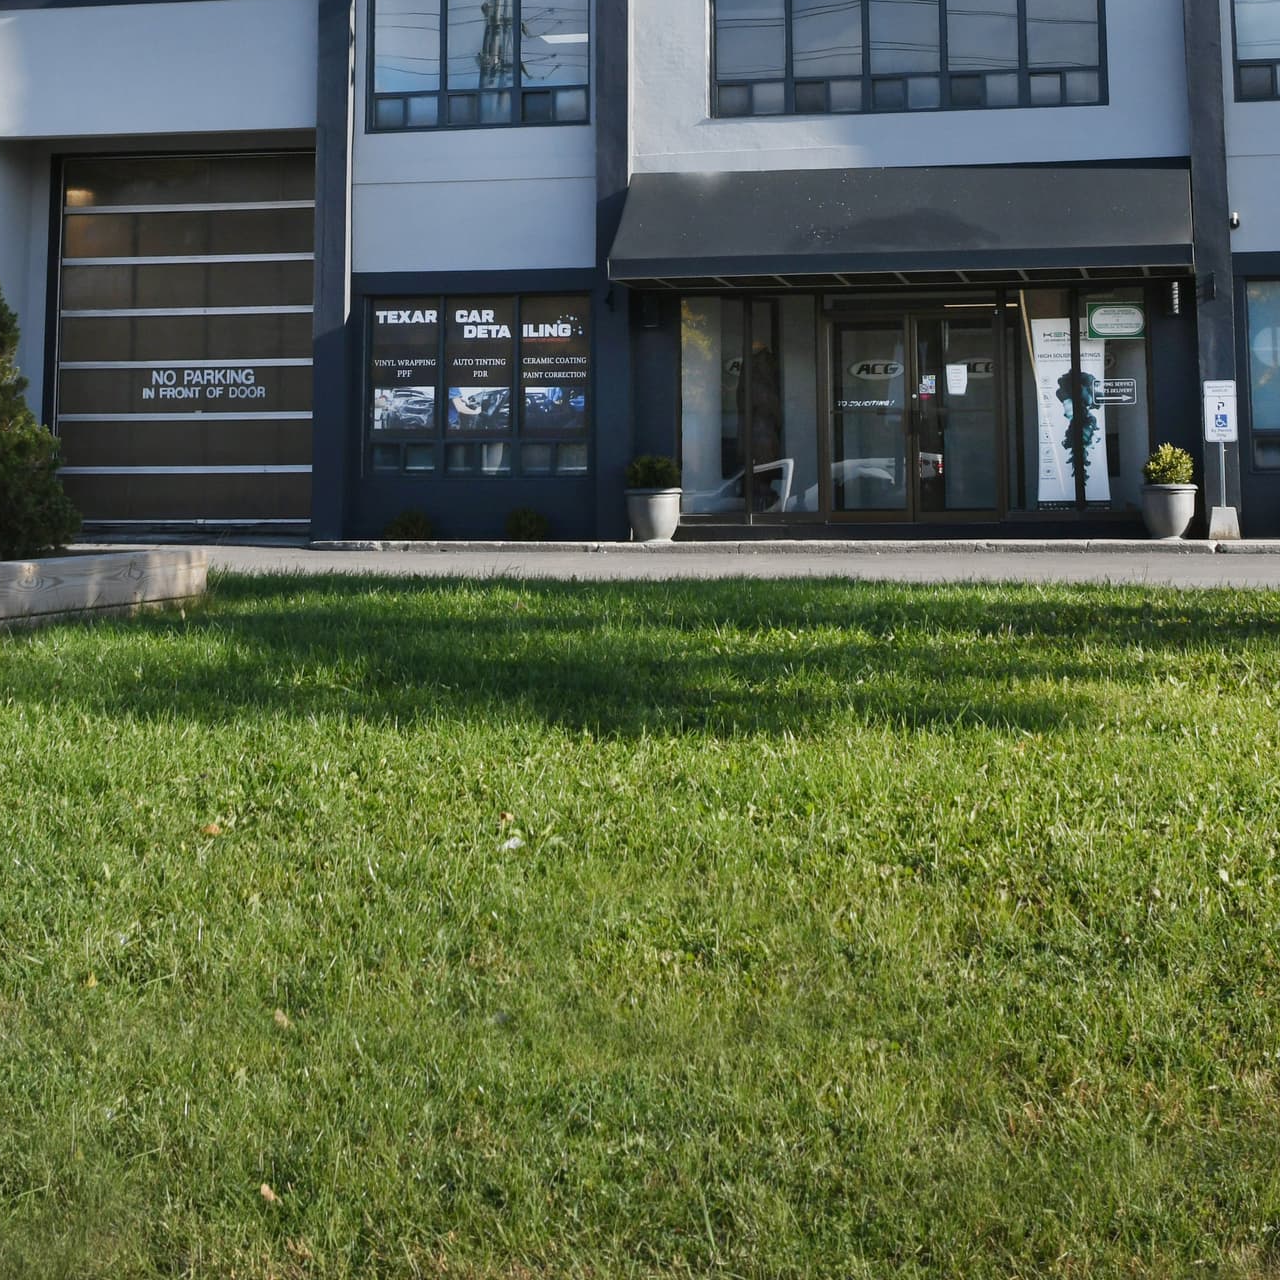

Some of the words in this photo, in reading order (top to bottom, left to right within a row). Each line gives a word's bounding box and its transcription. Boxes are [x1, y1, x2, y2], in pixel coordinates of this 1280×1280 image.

[375, 309, 438, 324] TEXAR
[455, 309, 495, 323] CAR
[374, 359, 396, 367] VINYL
[397, 358, 436, 366] WRAPPING
[453, 358, 474, 366] AUTO
[474, 358, 506, 366] TINTING
[522, 357, 555, 365] CERAMIC
[555, 356, 587, 364] COATING
[396, 369, 413, 378] PPF
[472, 369, 489, 378] PDR
[855, 363, 899, 375] ACG
[151, 370, 177, 386] NO
[183, 368, 256, 385] PARKING
[522, 371, 544, 379] PAINT
[544, 370, 587, 379] CORRECTION
[142, 387, 155, 400] IN
[159, 386, 202, 399] FRONT
[206, 386, 224, 399] OF
[228, 386, 266, 399] DOOR
